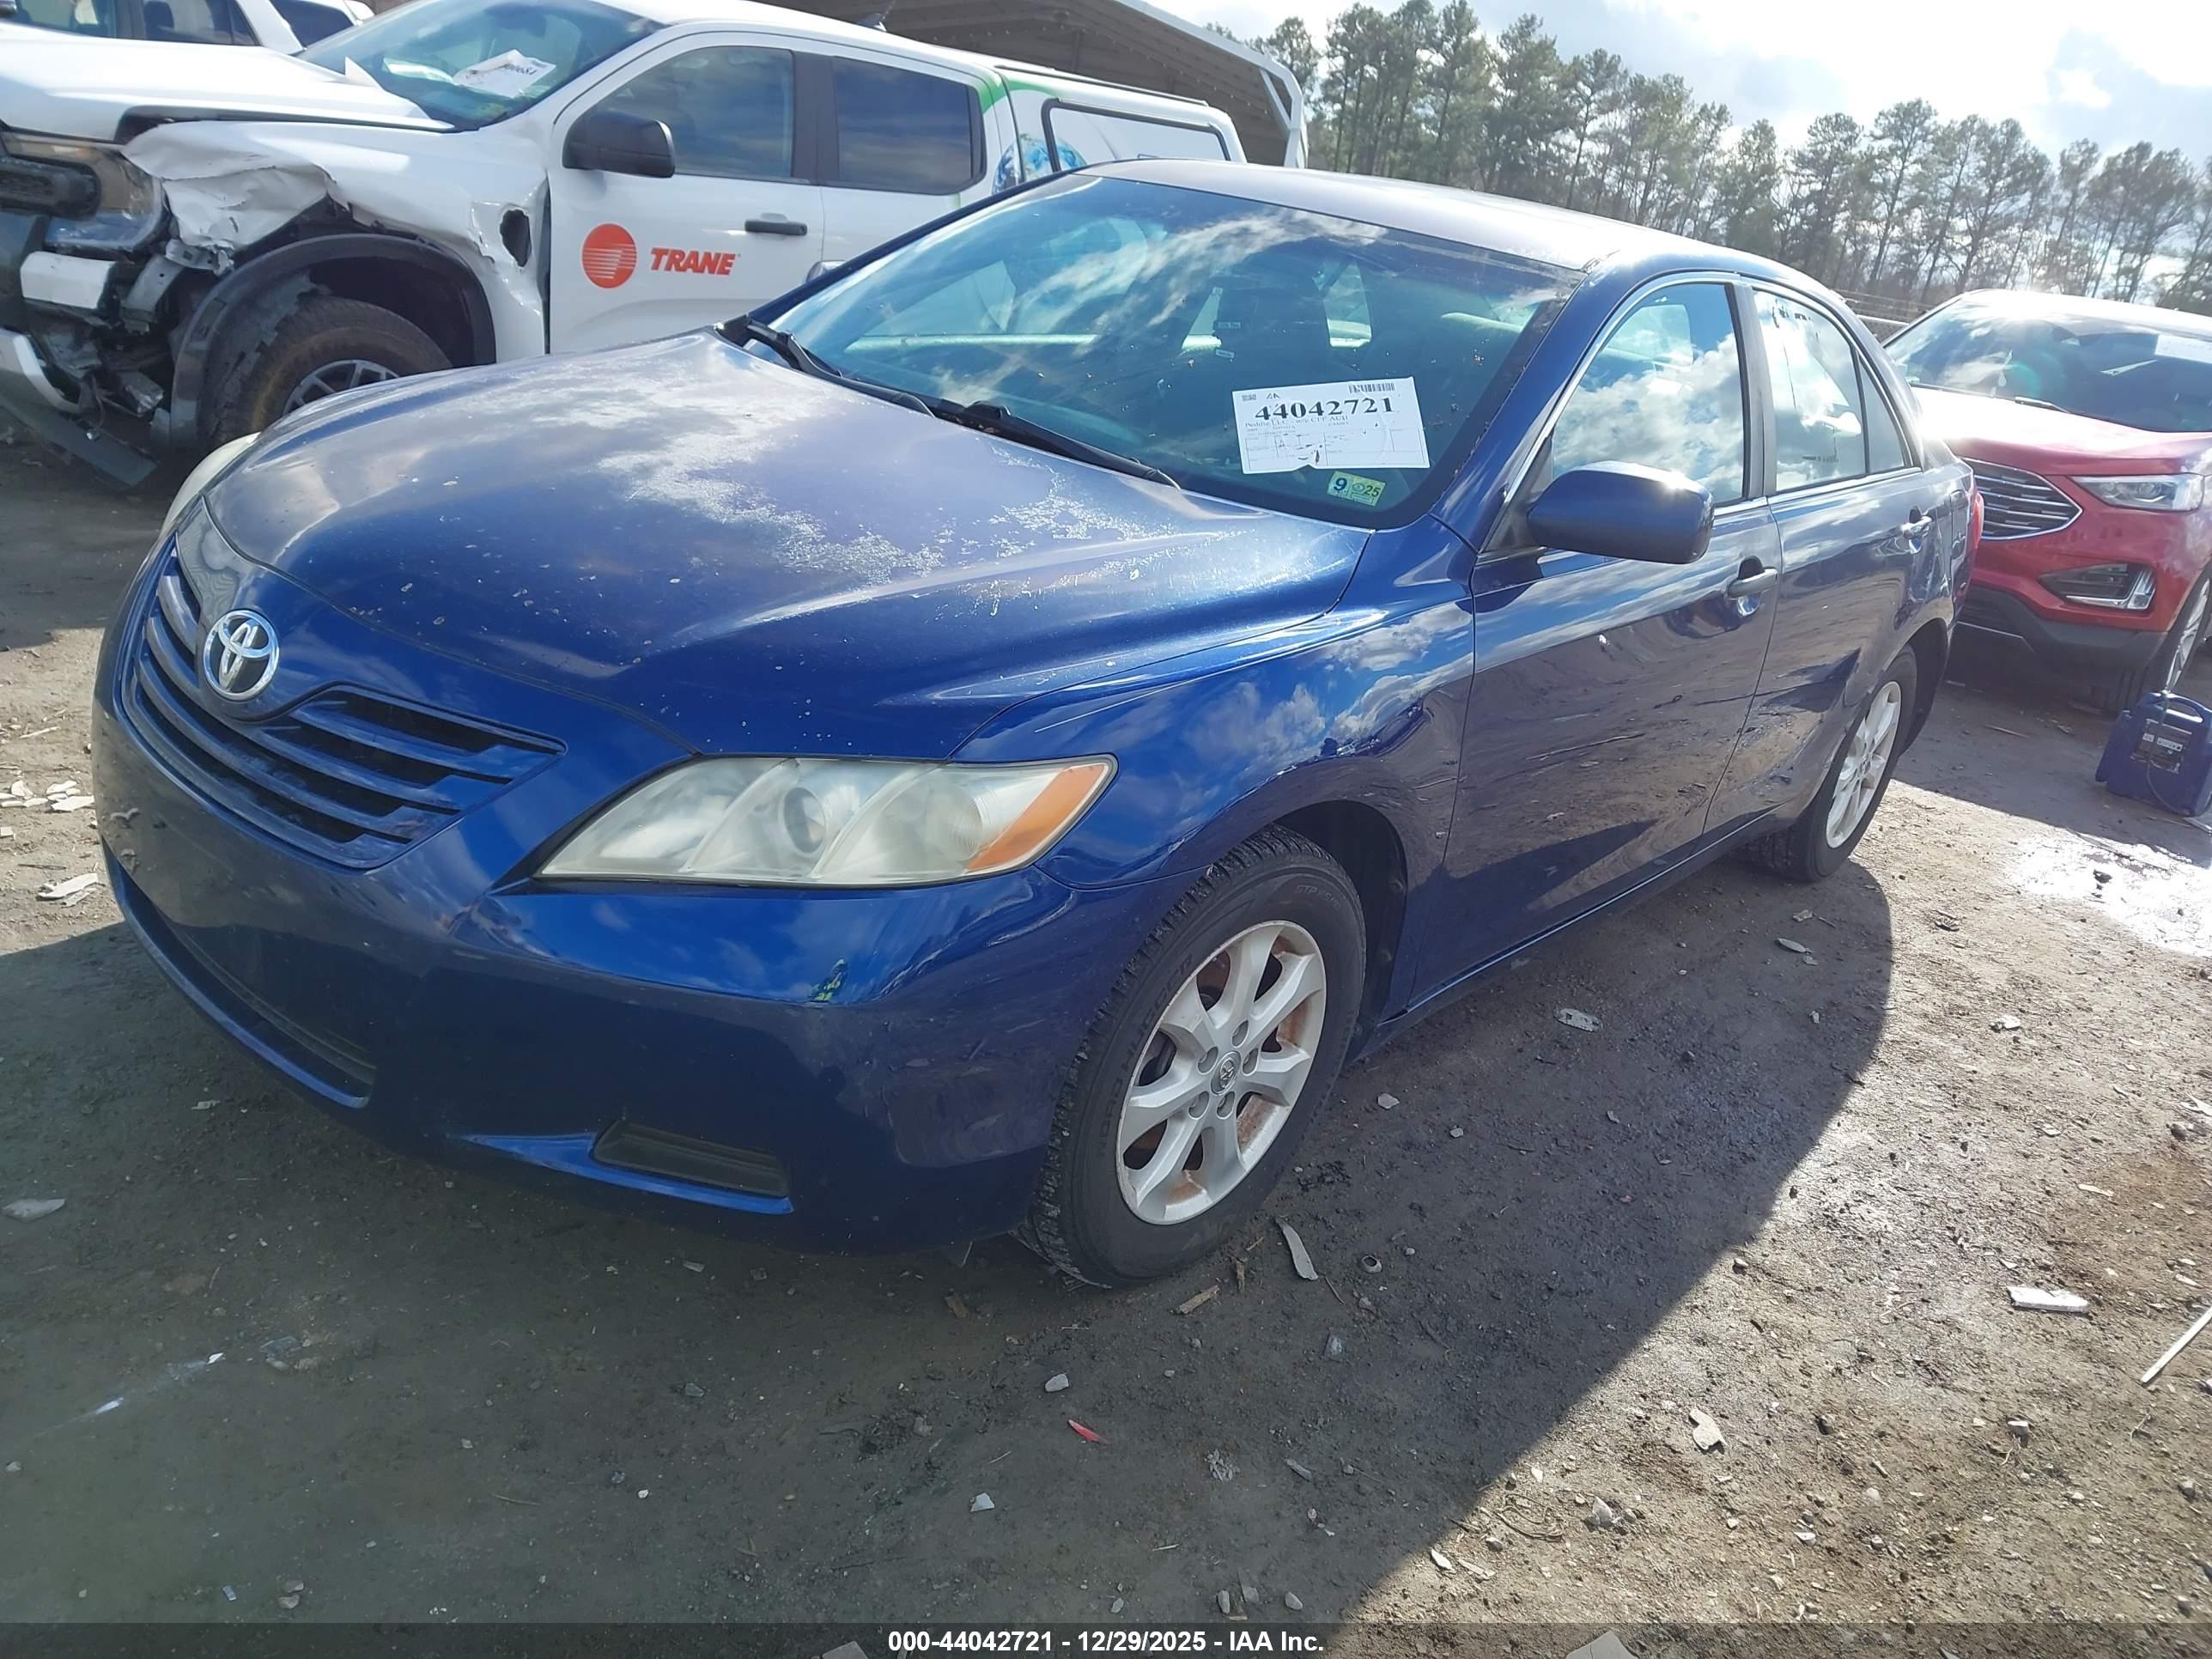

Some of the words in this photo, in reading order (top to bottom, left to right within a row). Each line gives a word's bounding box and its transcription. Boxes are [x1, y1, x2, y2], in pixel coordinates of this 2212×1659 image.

[651, 247, 736, 276] TRANE
[1255, 398, 1393, 420] 44042721
[1334, 477, 1348, 491] 9
[1364, 484, 1382, 497] 25
